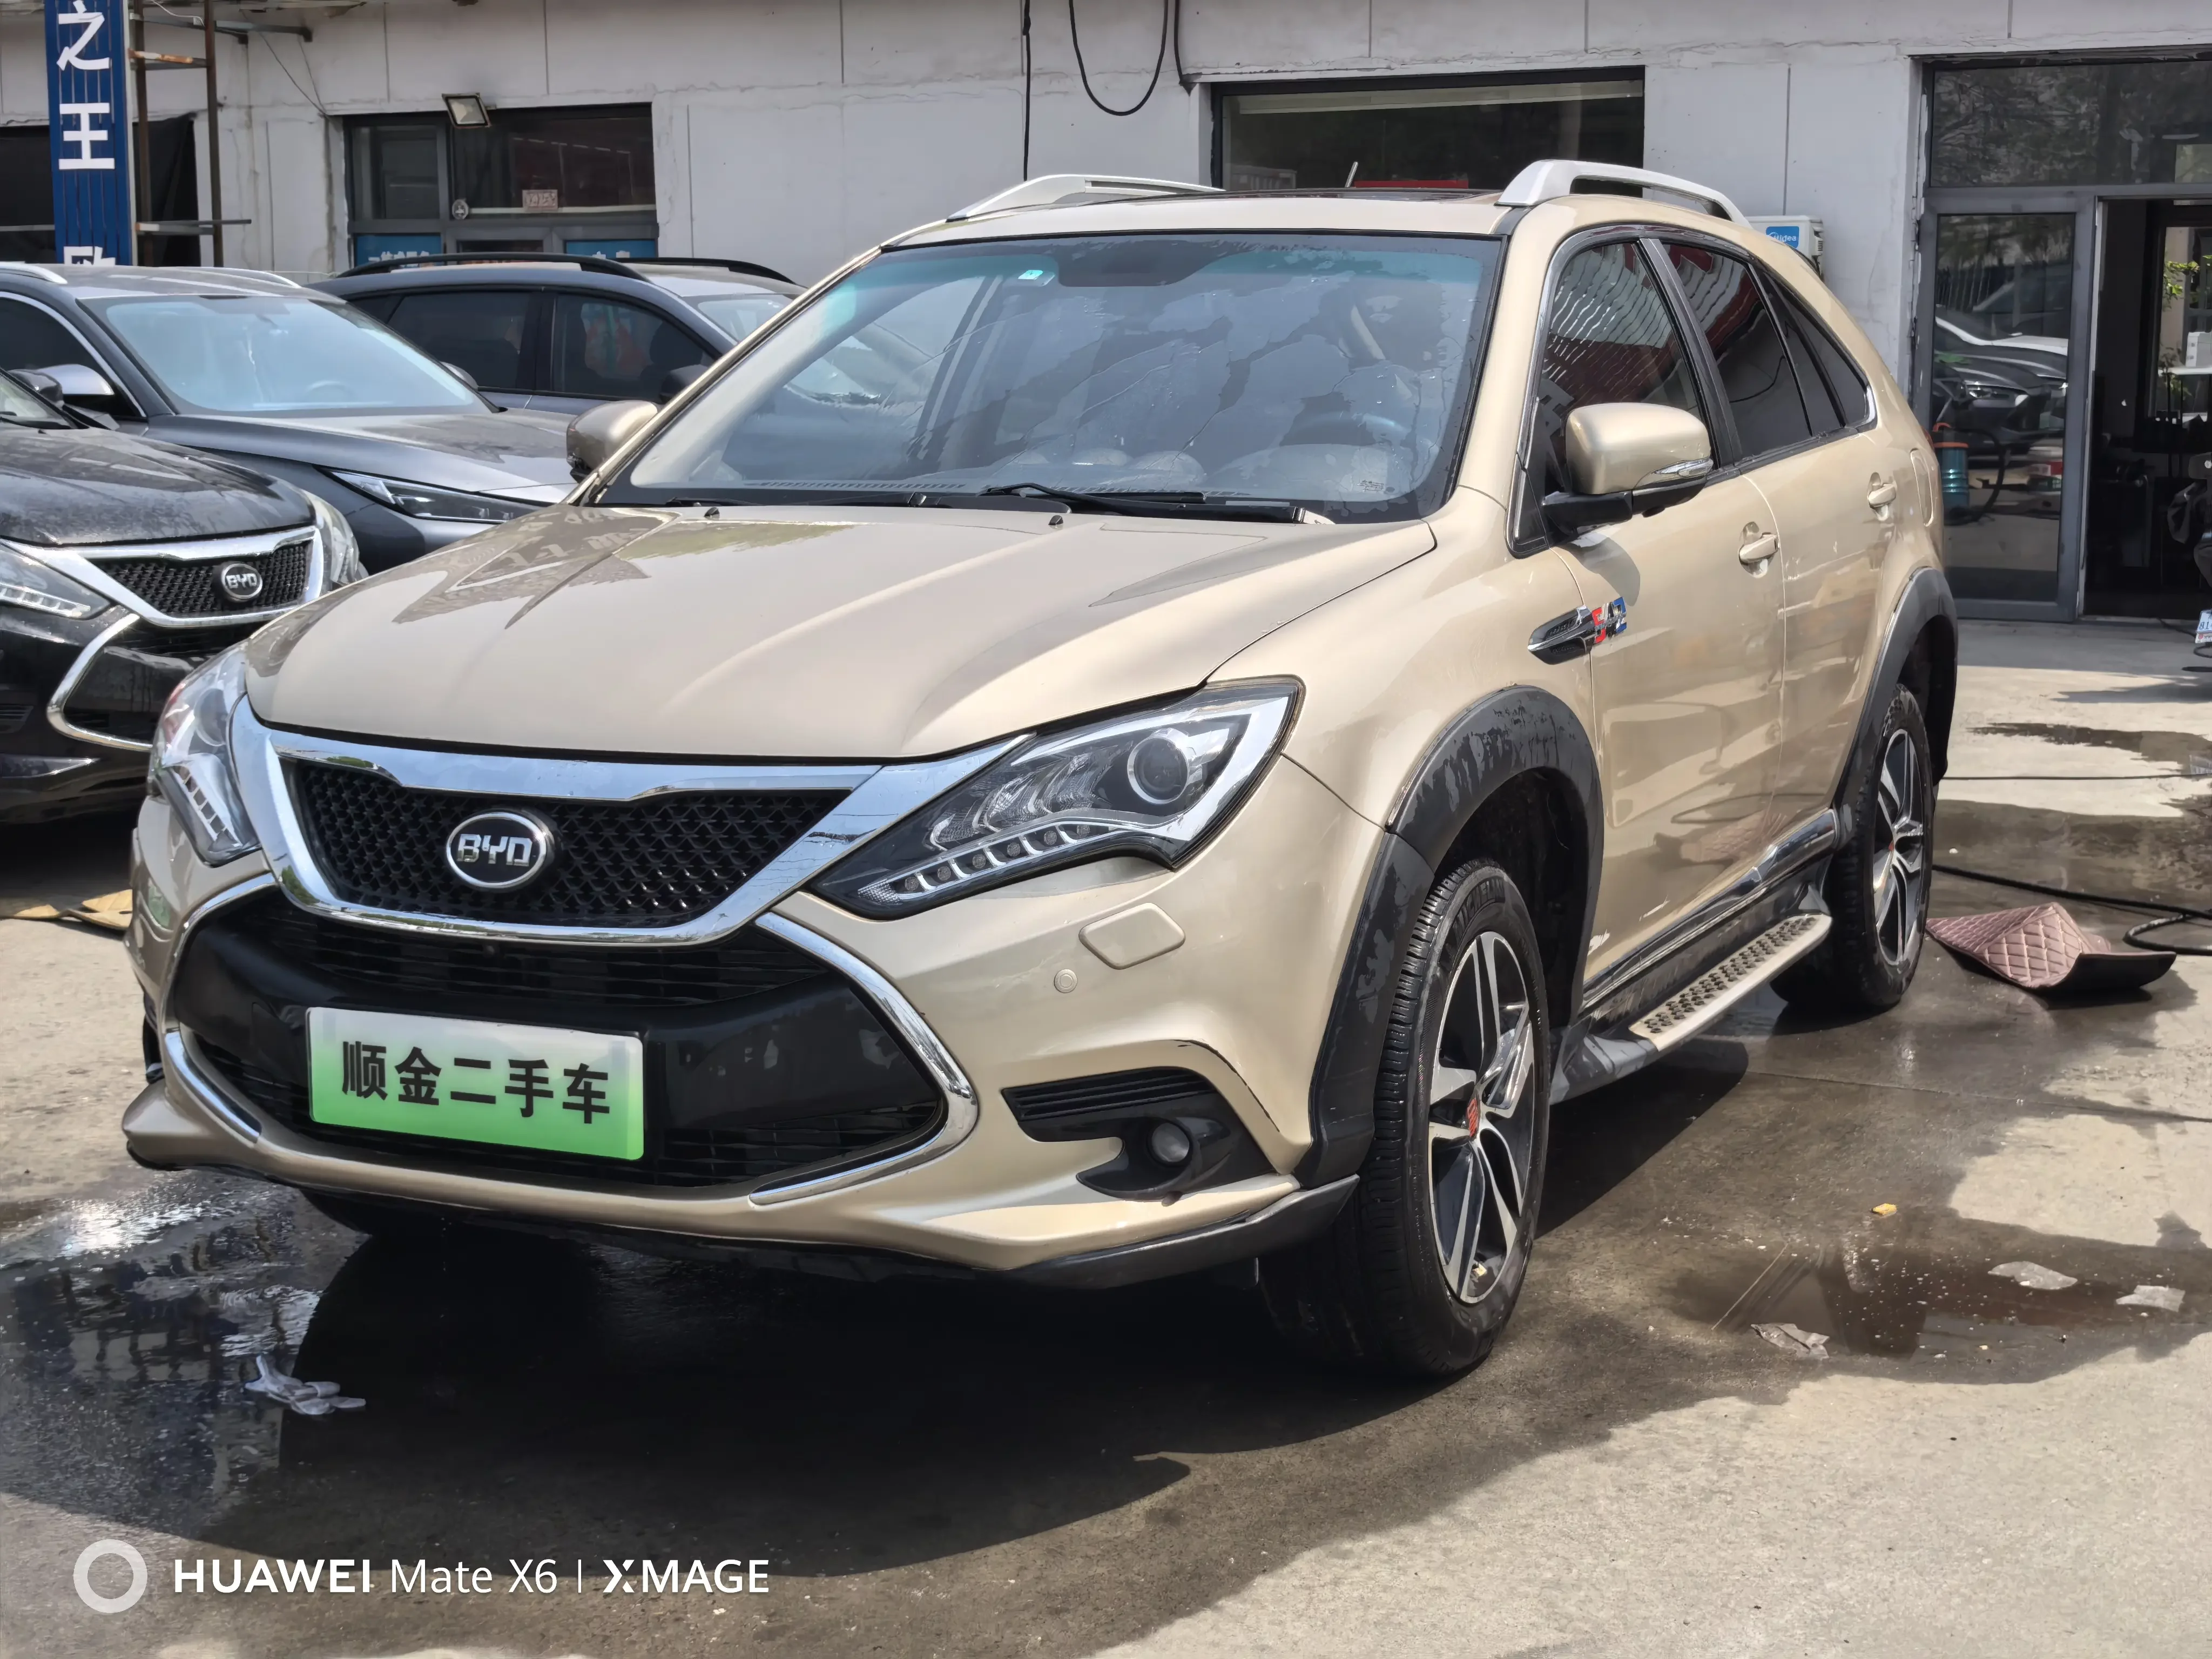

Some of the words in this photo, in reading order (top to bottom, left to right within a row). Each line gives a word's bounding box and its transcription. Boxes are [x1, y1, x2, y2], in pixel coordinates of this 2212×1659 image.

[226, 573, 258, 589] BYD
[457, 833, 532, 867] BYD
[342, 1041, 610, 1124] 顺金二手车
